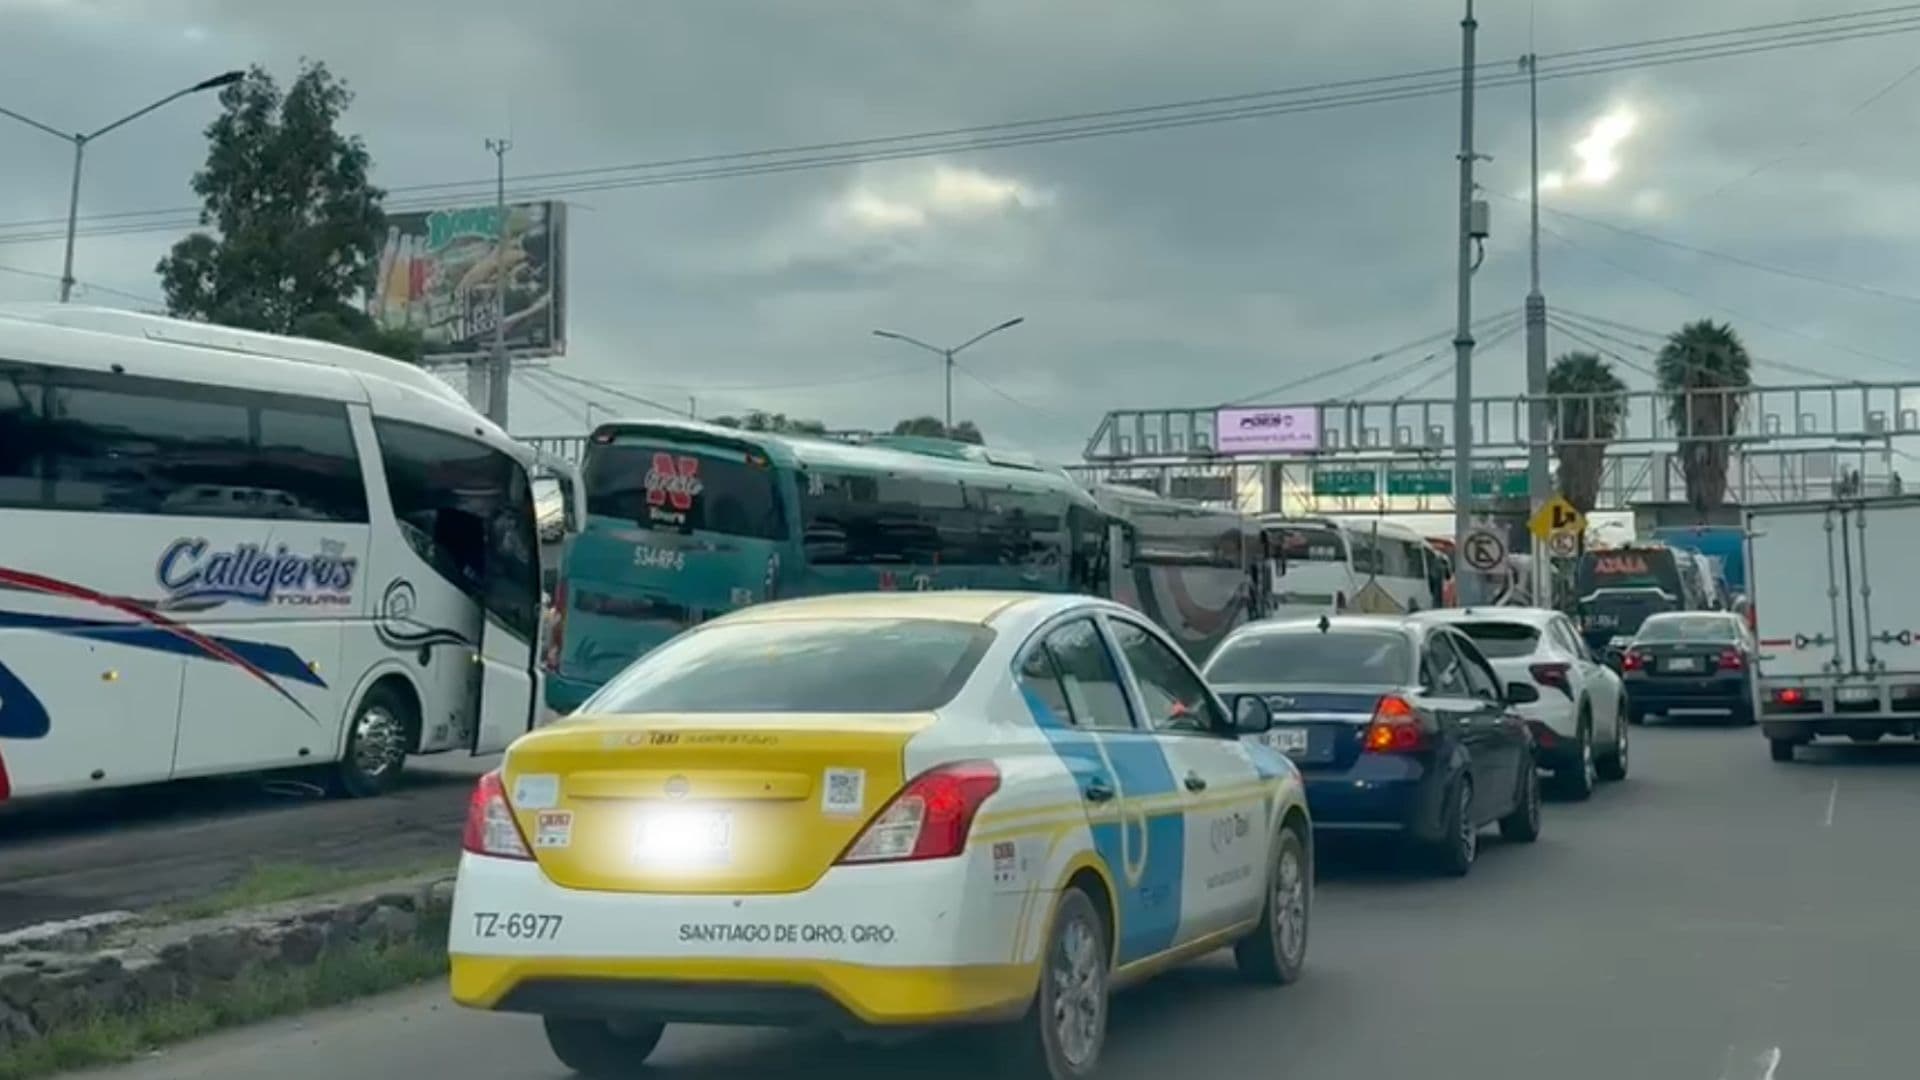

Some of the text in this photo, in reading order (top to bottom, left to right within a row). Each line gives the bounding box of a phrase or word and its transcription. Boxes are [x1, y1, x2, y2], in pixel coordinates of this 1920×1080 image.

[157, 536, 357, 604] Callejeros
[275, 594, 351, 606] TOURS
[474, 912, 563, 940] TZ-6977
[679, 924, 771, 942] SANTIAGO
[774, 924, 798, 942] DE
